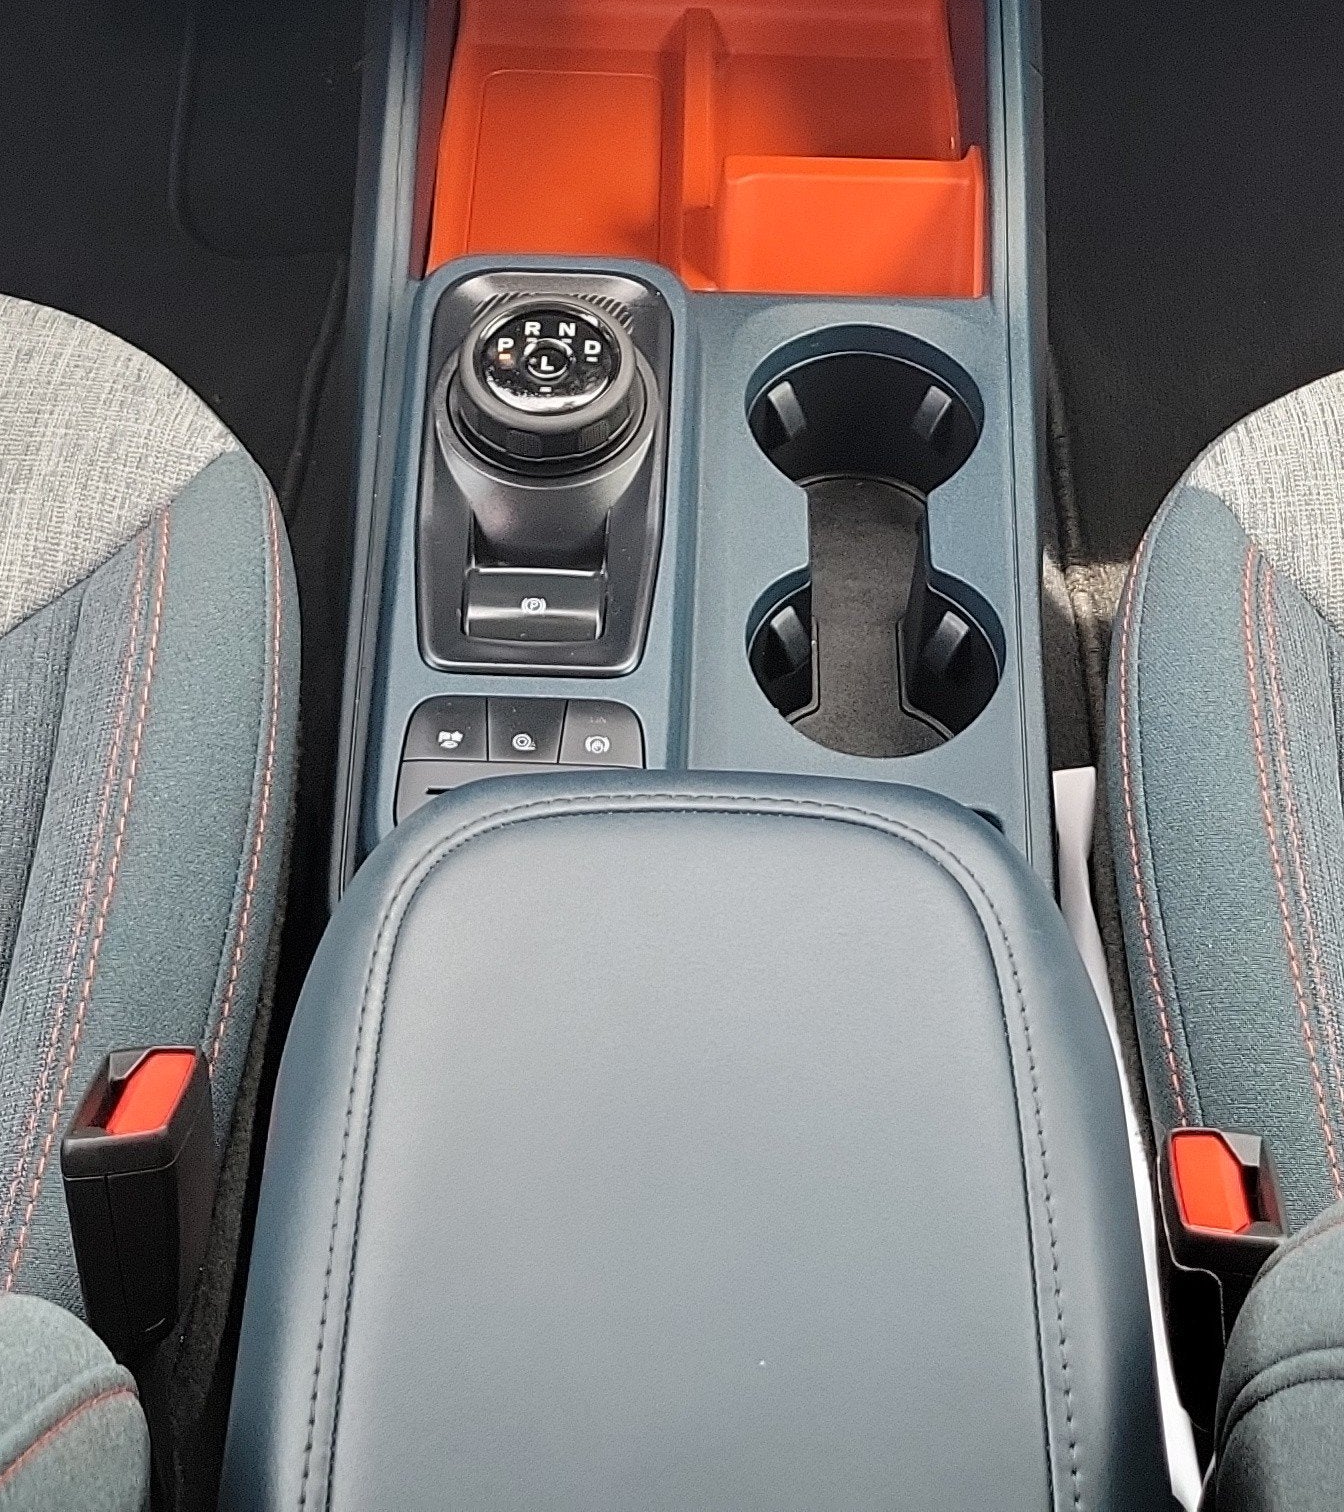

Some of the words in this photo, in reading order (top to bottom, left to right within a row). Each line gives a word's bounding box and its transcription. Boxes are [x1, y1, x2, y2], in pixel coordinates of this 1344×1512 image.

[524, 321, 541, 336] R
[558, 322, 576, 337] N
[497, 337, 514, 352] P
[584, 339, 602, 355] D
[540, 355, 555, 371] L
